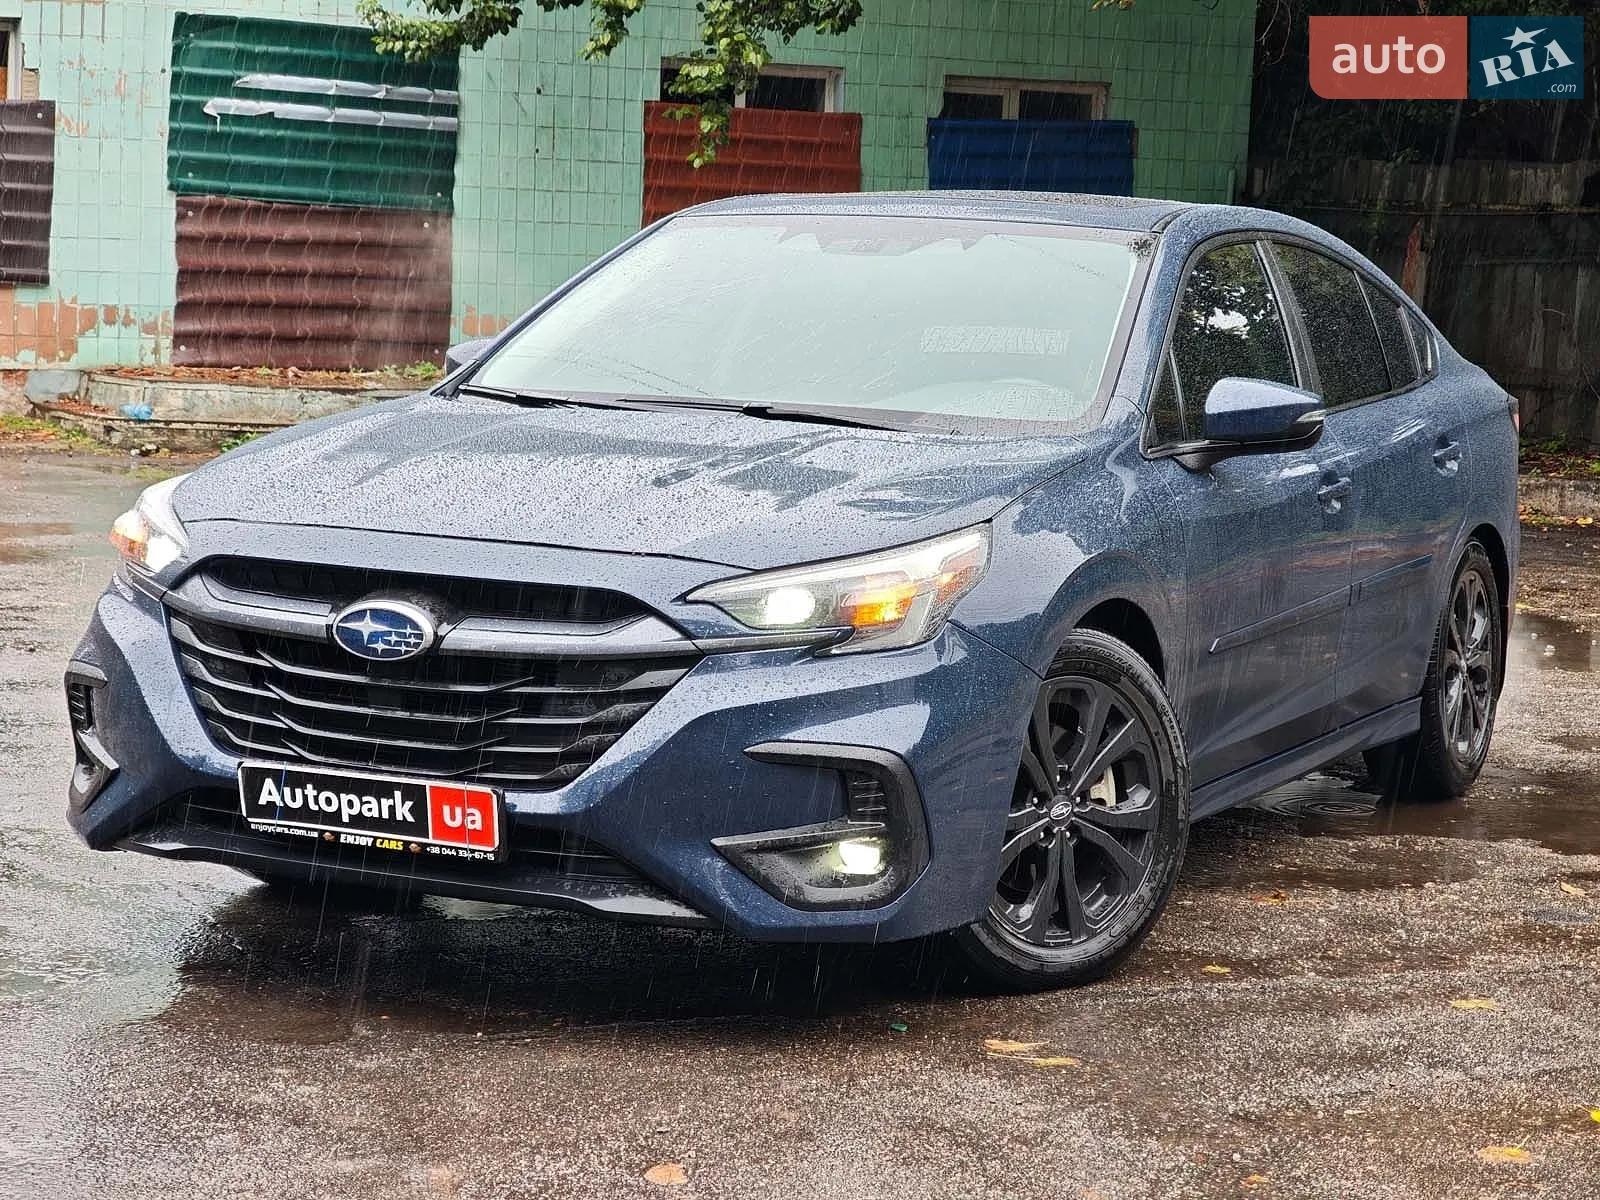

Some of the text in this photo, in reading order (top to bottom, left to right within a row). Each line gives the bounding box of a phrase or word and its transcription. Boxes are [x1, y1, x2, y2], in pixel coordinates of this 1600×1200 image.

[258, 778, 482, 831] Autopark ua
[250, 823, 319, 838] enjoycars.com.ua
[340, 833, 374, 848] ENJOY
[375, 838, 403, 851] CARS
[426, 846, 441, 854] +38
